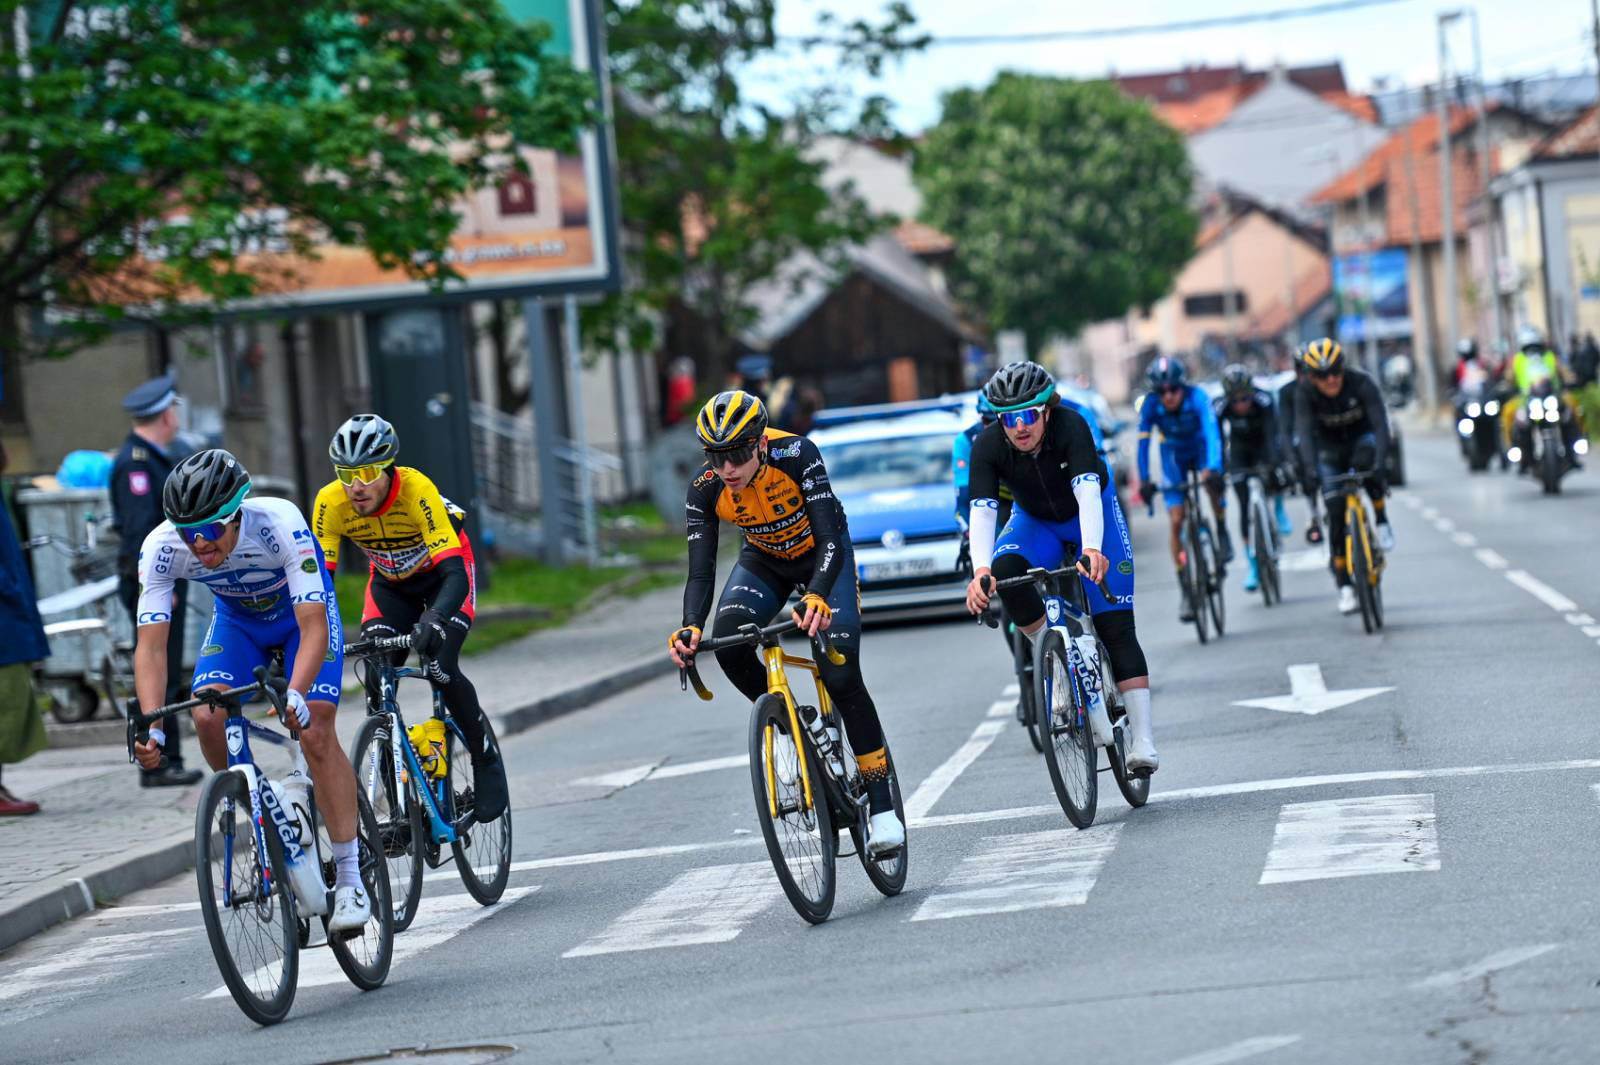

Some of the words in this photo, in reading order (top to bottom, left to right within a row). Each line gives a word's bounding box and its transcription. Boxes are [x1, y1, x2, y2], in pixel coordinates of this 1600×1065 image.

[260, 526, 280, 554] GEO
[155, 545, 173, 574] GEO
[307, 683, 340, 697] ICO
